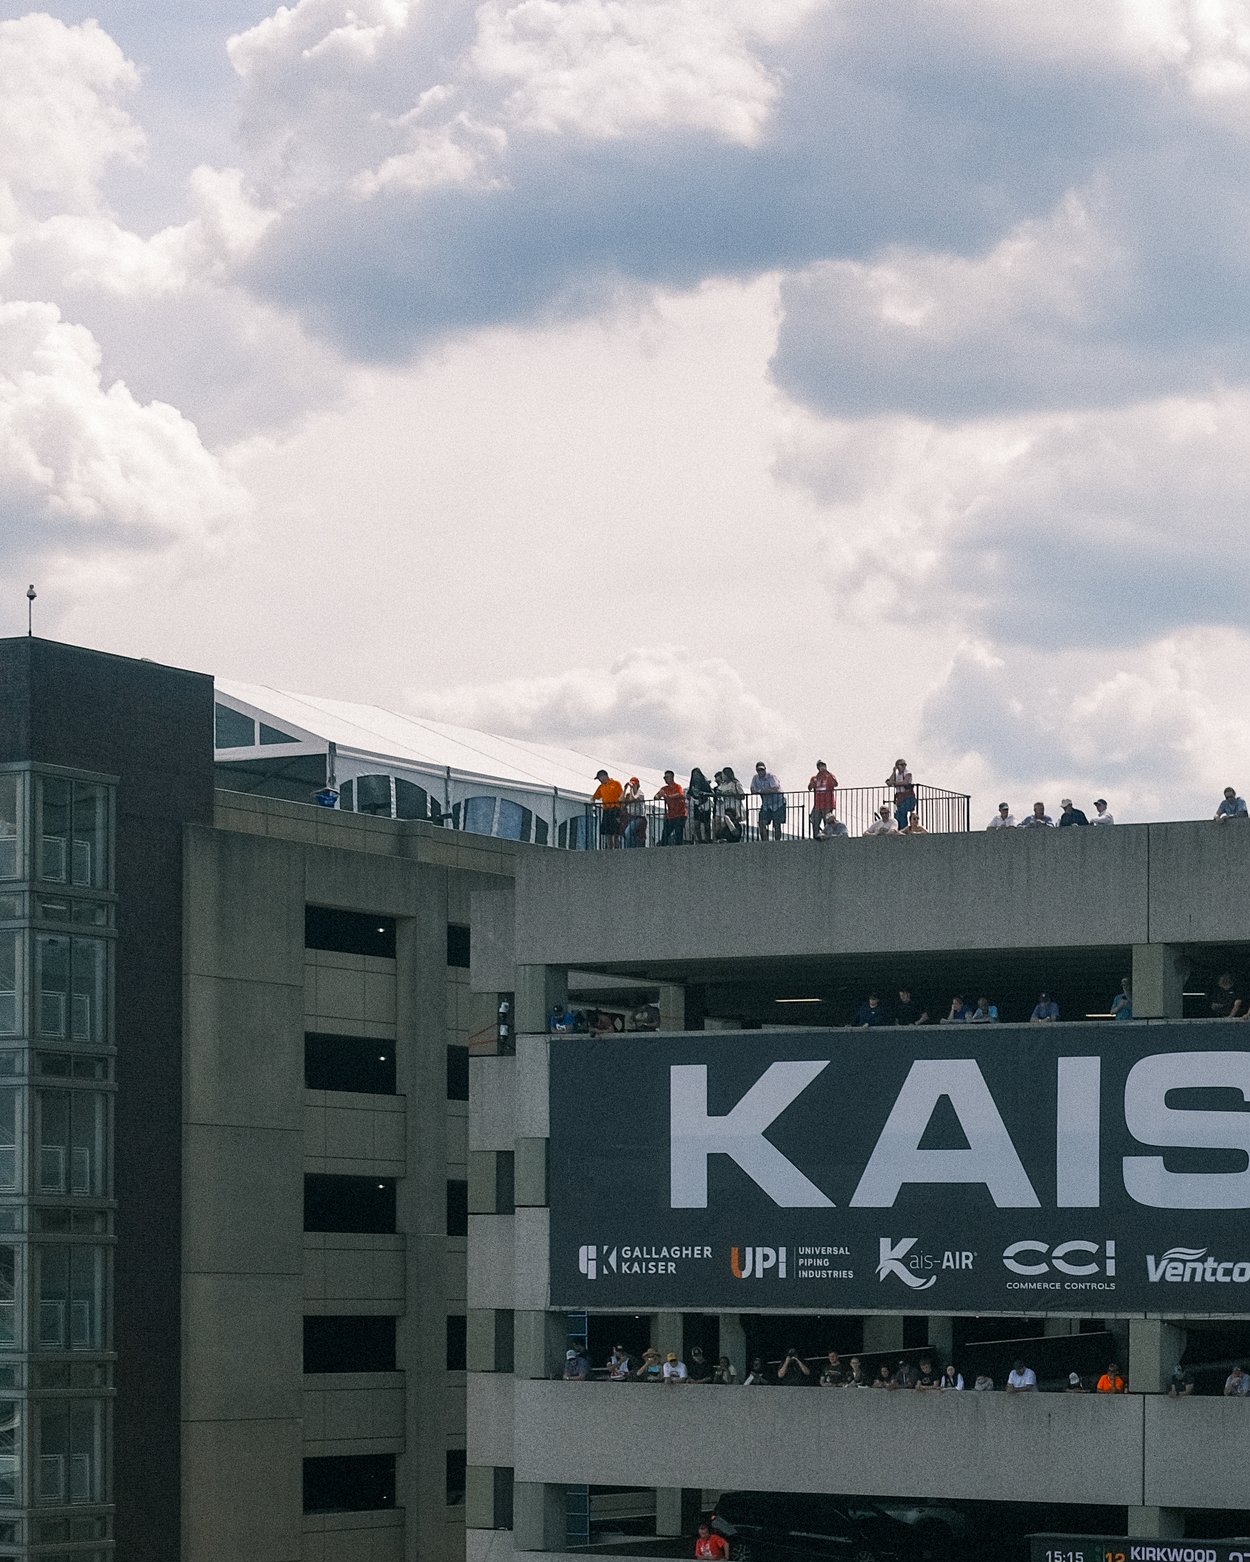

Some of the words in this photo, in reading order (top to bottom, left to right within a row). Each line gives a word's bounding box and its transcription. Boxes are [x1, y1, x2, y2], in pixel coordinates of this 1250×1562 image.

[621, 1246, 712, 1259] GALLAGHER
[798, 1246, 850, 1255] UNIVERSAL
[730, 1246, 786, 1279] UPI
[798, 1258, 830, 1267] PIPING
[1002, 1240, 1116, 1276] CCI
[621, 1261, 677, 1274] KAISER
[798, 1269, 854, 1279] INDUSTRIES
[1006, 1282, 1061, 1290] COMMERCE
[1064, 1282, 1116, 1290] CONTROLS
